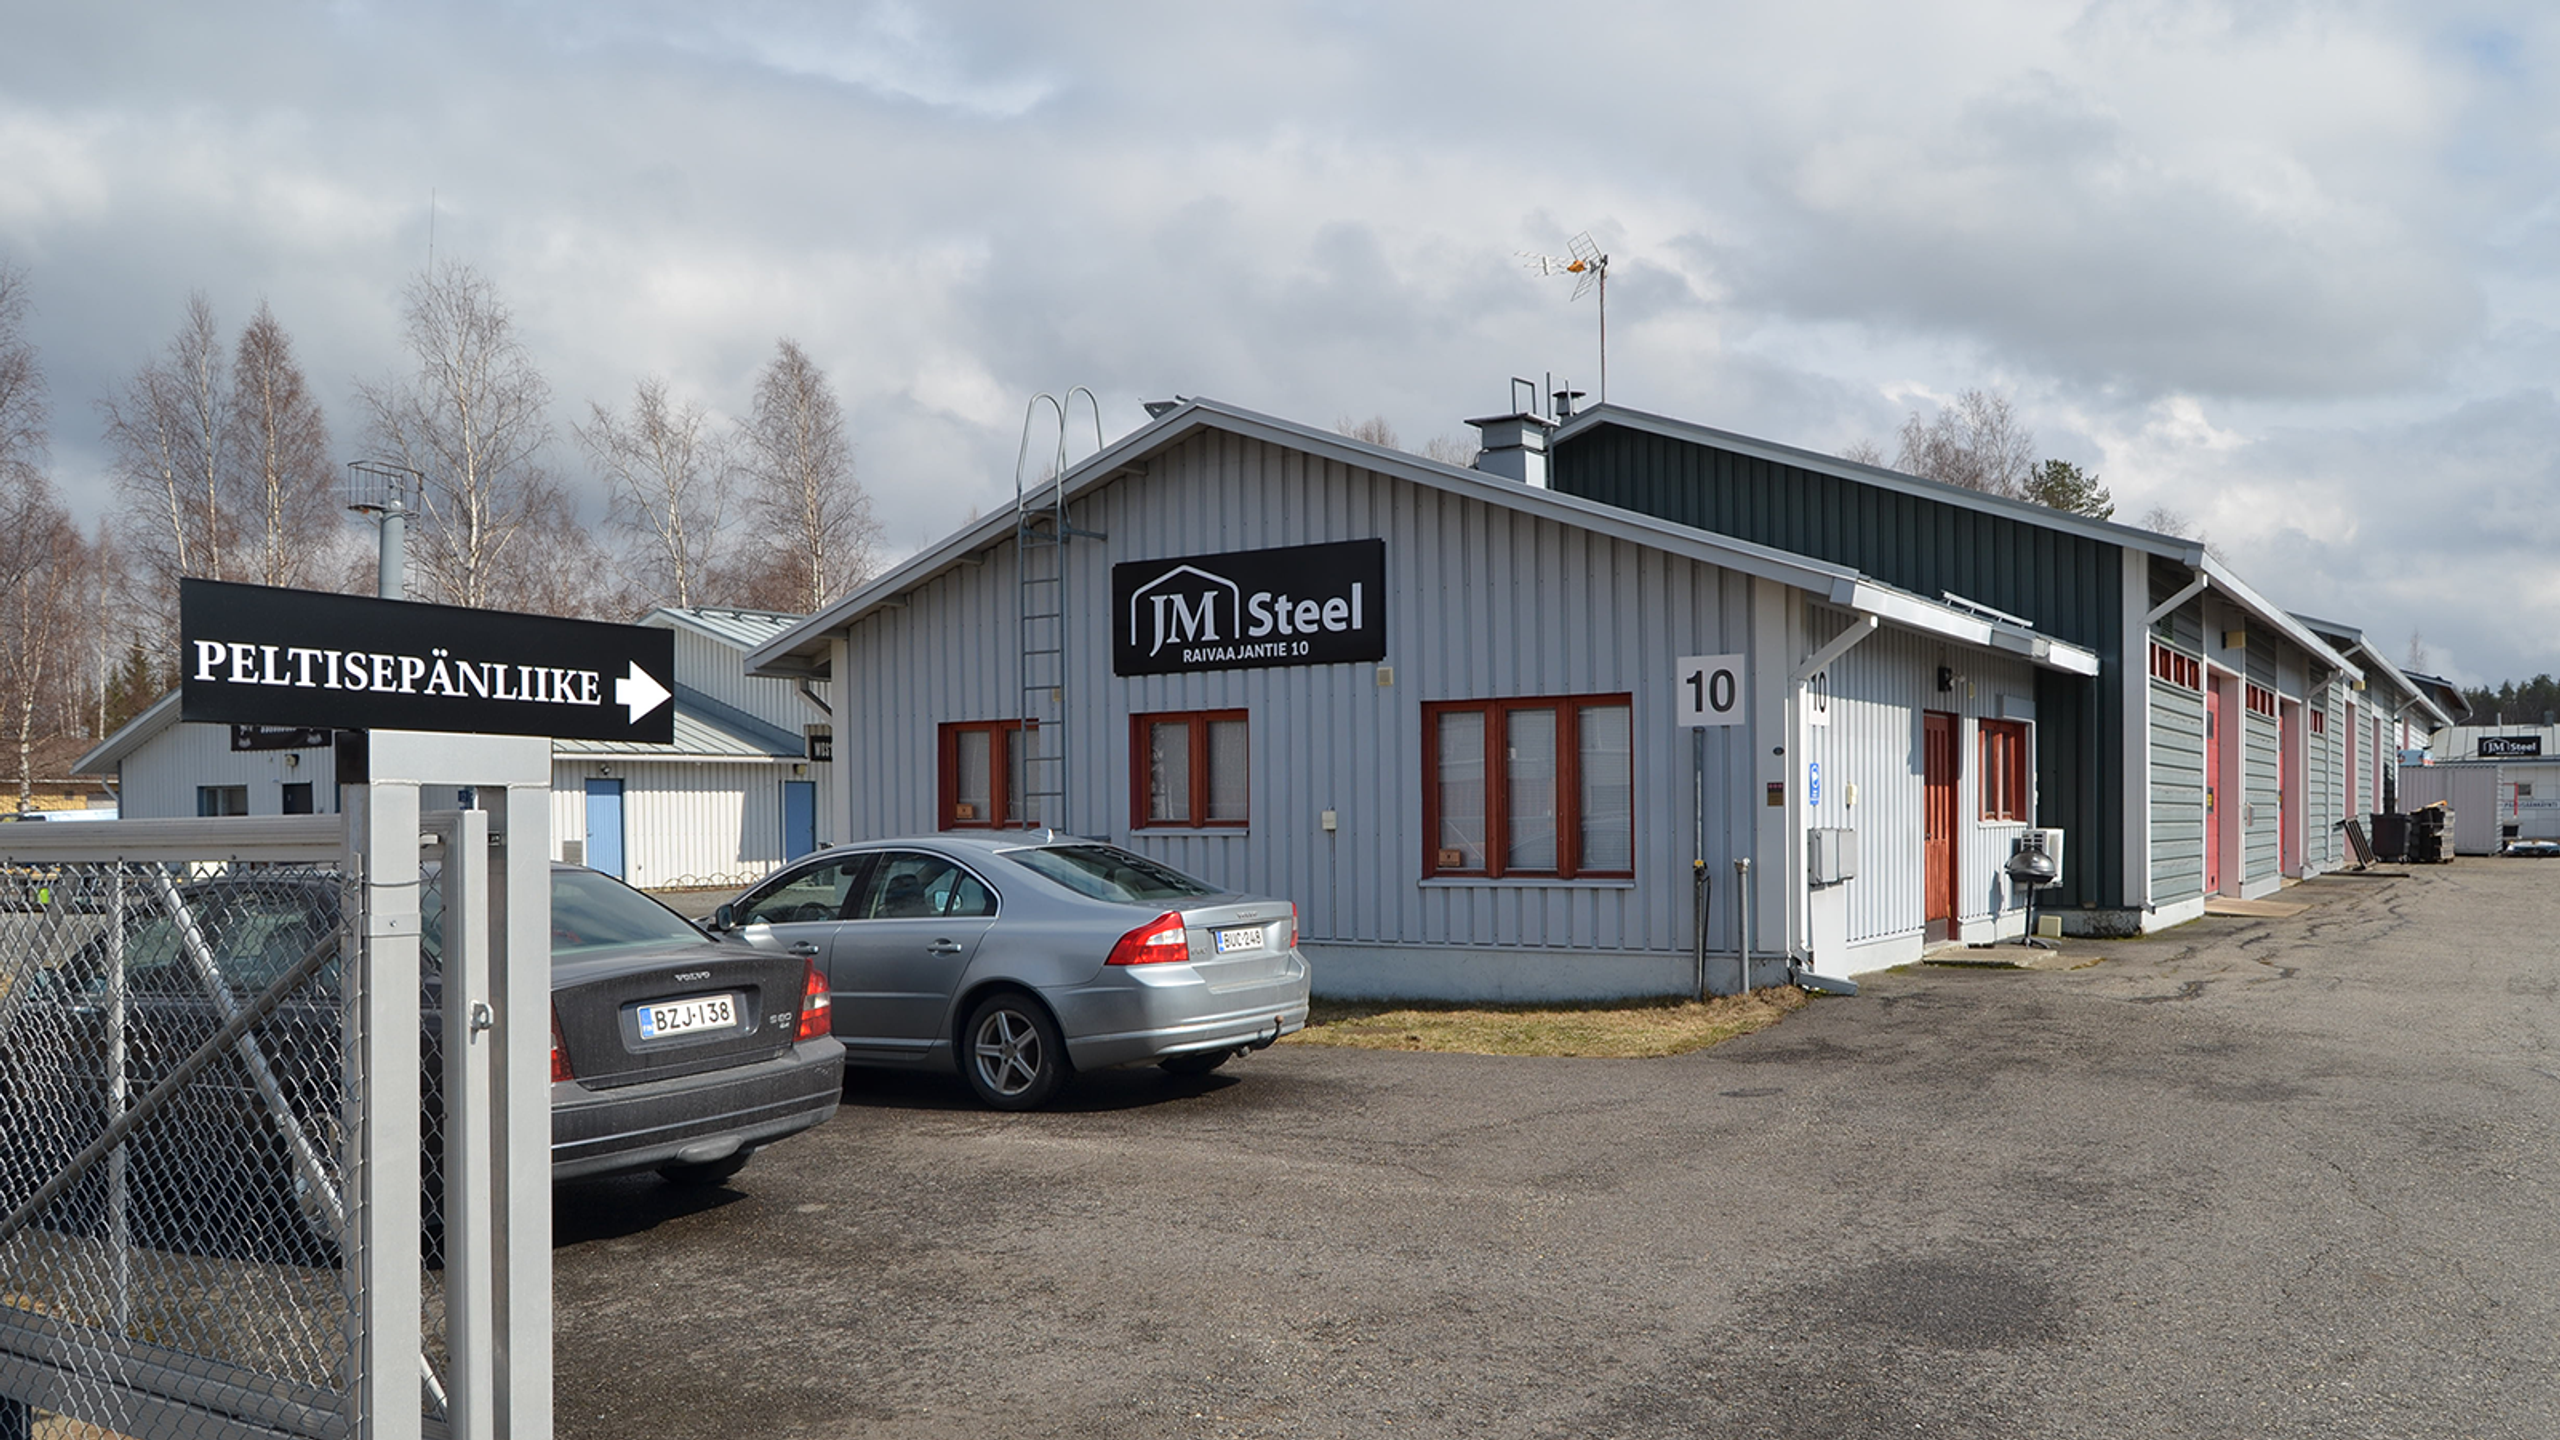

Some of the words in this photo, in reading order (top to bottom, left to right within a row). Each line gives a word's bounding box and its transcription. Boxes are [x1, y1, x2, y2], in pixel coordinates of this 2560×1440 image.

[1149, 590, 1220, 657] JM
[1248, 582, 1362, 637] Steel
[192, 639, 602, 706] PELTISEPÄNLIIKE
[1183, 642, 1287, 663] RAIVAAJANTIE
[1291, 640, 1309, 656] 10
[1686, 668, 1736, 713] 10
[1811, 671, 1827, 713] 10
[2510, 742, 2536, 752] Steel
[675, 971, 711, 982] VOLVO
